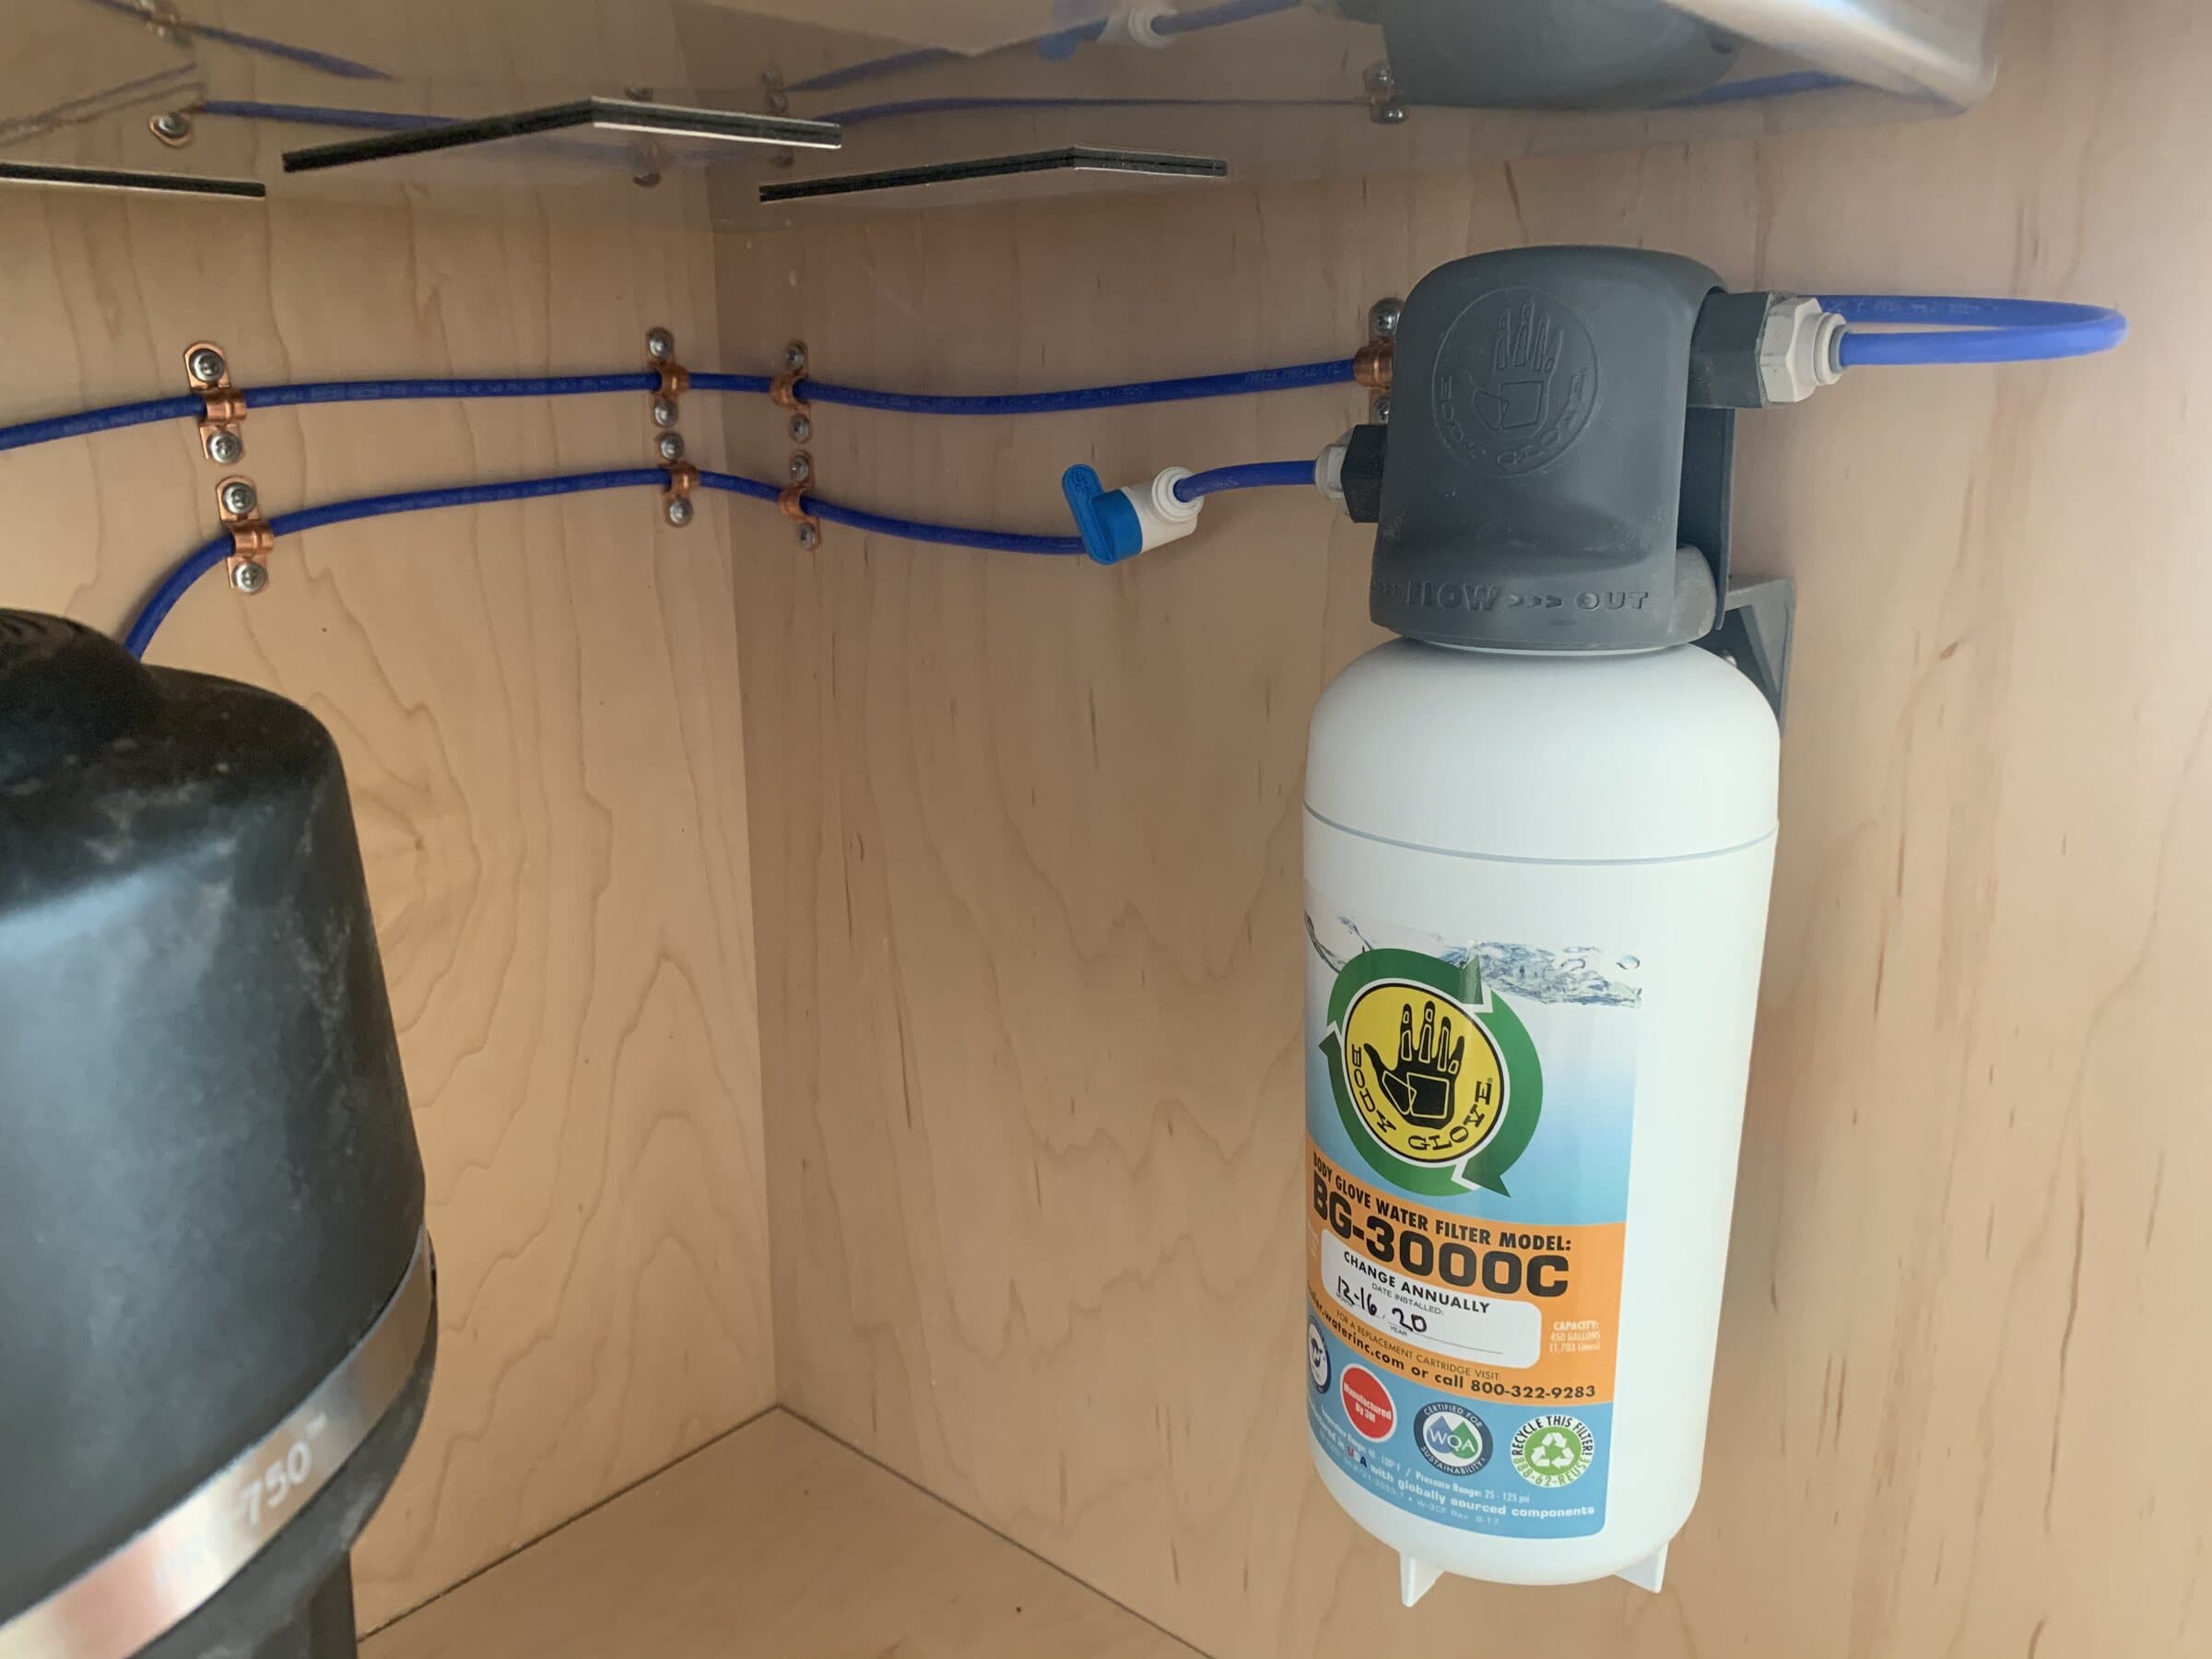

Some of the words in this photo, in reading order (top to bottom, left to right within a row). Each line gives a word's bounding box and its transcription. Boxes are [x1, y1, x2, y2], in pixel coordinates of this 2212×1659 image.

[1576, 590, 1650, 611] OUT
[1351, 1043, 1397, 1134] BODY
[1407, 1078, 1493, 1152] GLOVE
[1313, 1150, 1333, 1183] BODY
[1335, 1174, 1371, 1211] GLOVE
[1375, 1197, 1430, 1232] WATER
[1435, 1218, 1491, 1246] FILTER
[1499, 1230, 1571, 1252] MODEL:
[1313, 1168, 1570, 1298] BG-3000C
[1344, 1250, 1396, 1288] CHANGE
[1401, 1280, 1491, 1314] ANNUALLY
[1371, 1281, 1393, 1299] DATE
[1394, 1292, 1444, 1317] INSTALLED:
[1336, 1275, 1378, 1316] 12-16
[1391, 1307, 1428, 1333] 20
[1336, 1309, 1349, 1325] FOR
[1350, 1320, 1357, 1329] A
[1357, 1324, 1414, 1360] REPLACEMENT
[1415, 1353, 1472, 1377] CARTRIDGE
[1389, 1324, 1408, 1337] YEAR
[1553, 1320, 1600, 1332] CAPACITY:
[1410, 1365, 1430, 1380] or
[1434, 1373, 1465, 1389] call
[1470, 1379, 1596, 1399] 800-322-9283
[1343, 1381, 1393, 1422] Manufactured
[1423, 1403, 1465, 1417] CERTIFIED
[1465, 1414, 1483, 1429] FOR
[1429, 1428, 1476, 1454] WQA
[1512, 1418, 1544, 1456] RECYCLE
[1546, 1415, 1573, 1428] THIS
[1571, 1422, 1594, 1456] FILTER!
[1419, 1444, 1484, 1476] SUSTAINABILITY
[1512, 1456, 1590, 1488] 888-62-REUSE
[1370, 1464, 1394, 1483] with
[1397, 1478, 1446, 1506] globally
[1450, 1498, 1507, 1515] sourced
[1511, 1505, 1595, 1521] components
